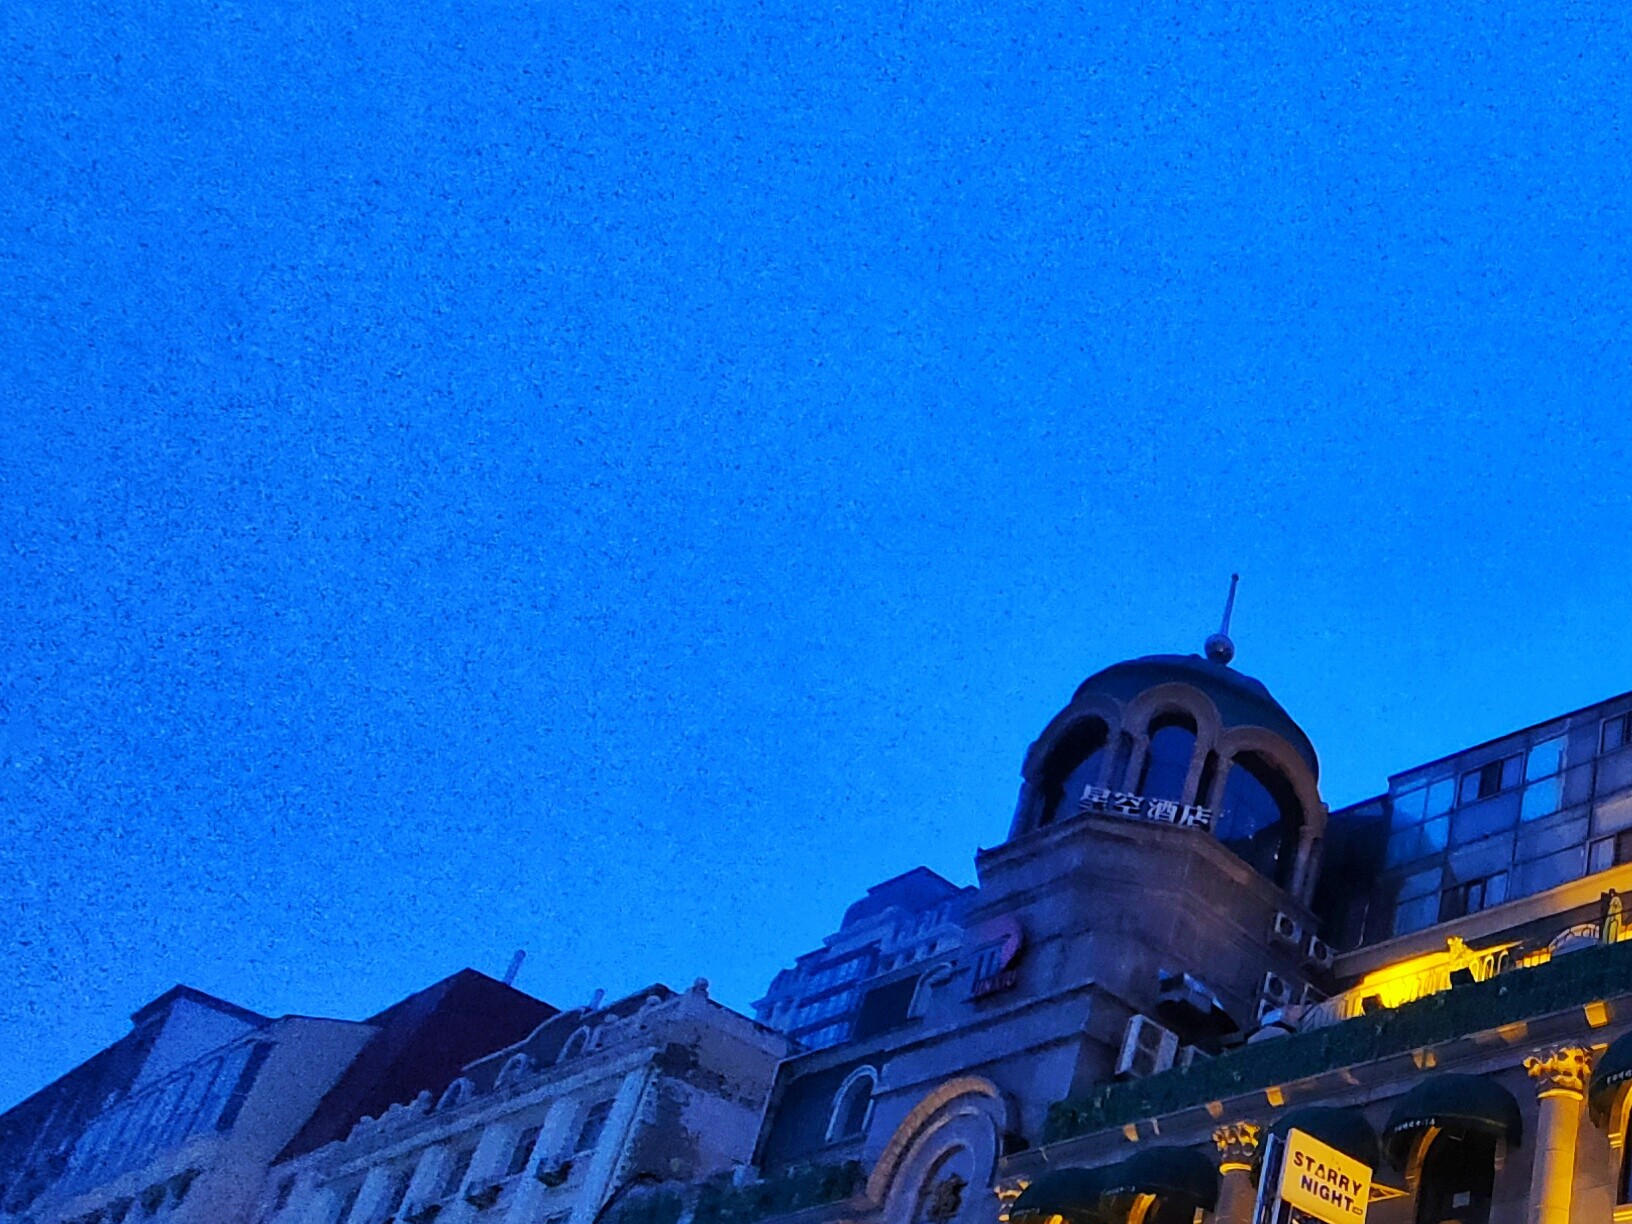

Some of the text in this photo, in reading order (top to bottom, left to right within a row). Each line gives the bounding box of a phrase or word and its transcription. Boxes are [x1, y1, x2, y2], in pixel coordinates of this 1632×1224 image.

[1078, 783, 1215, 829] 星空酒店
[1293, 1151, 1363, 1198] STARRY
[1301, 1174, 1354, 1212] NIGHT
